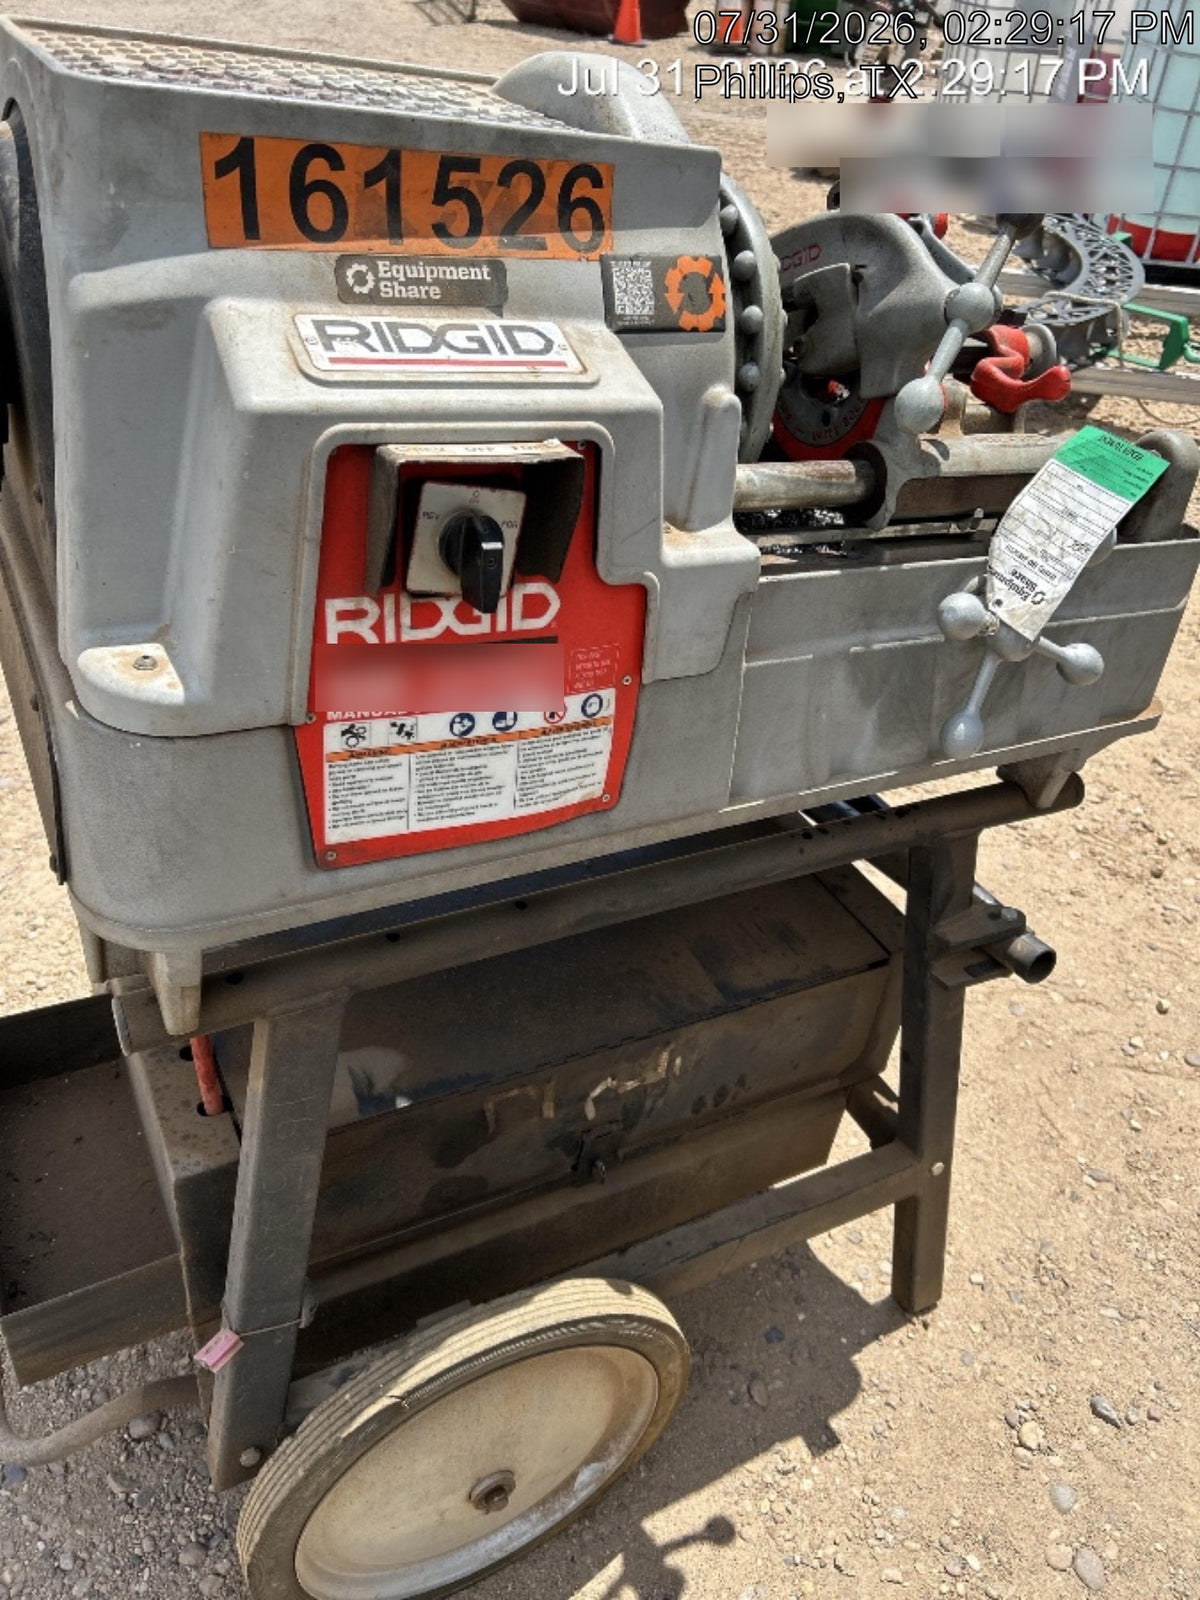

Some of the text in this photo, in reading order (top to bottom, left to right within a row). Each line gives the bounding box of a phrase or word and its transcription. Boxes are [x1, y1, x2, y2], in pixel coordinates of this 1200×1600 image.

[212, 136, 606, 251] 161526
[376, 260, 492, 283] Equipment
[379, 280, 442, 300] Share
[311, 319, 555, 356] RIDGID
[324, 582, 561, 645] RIDGID
